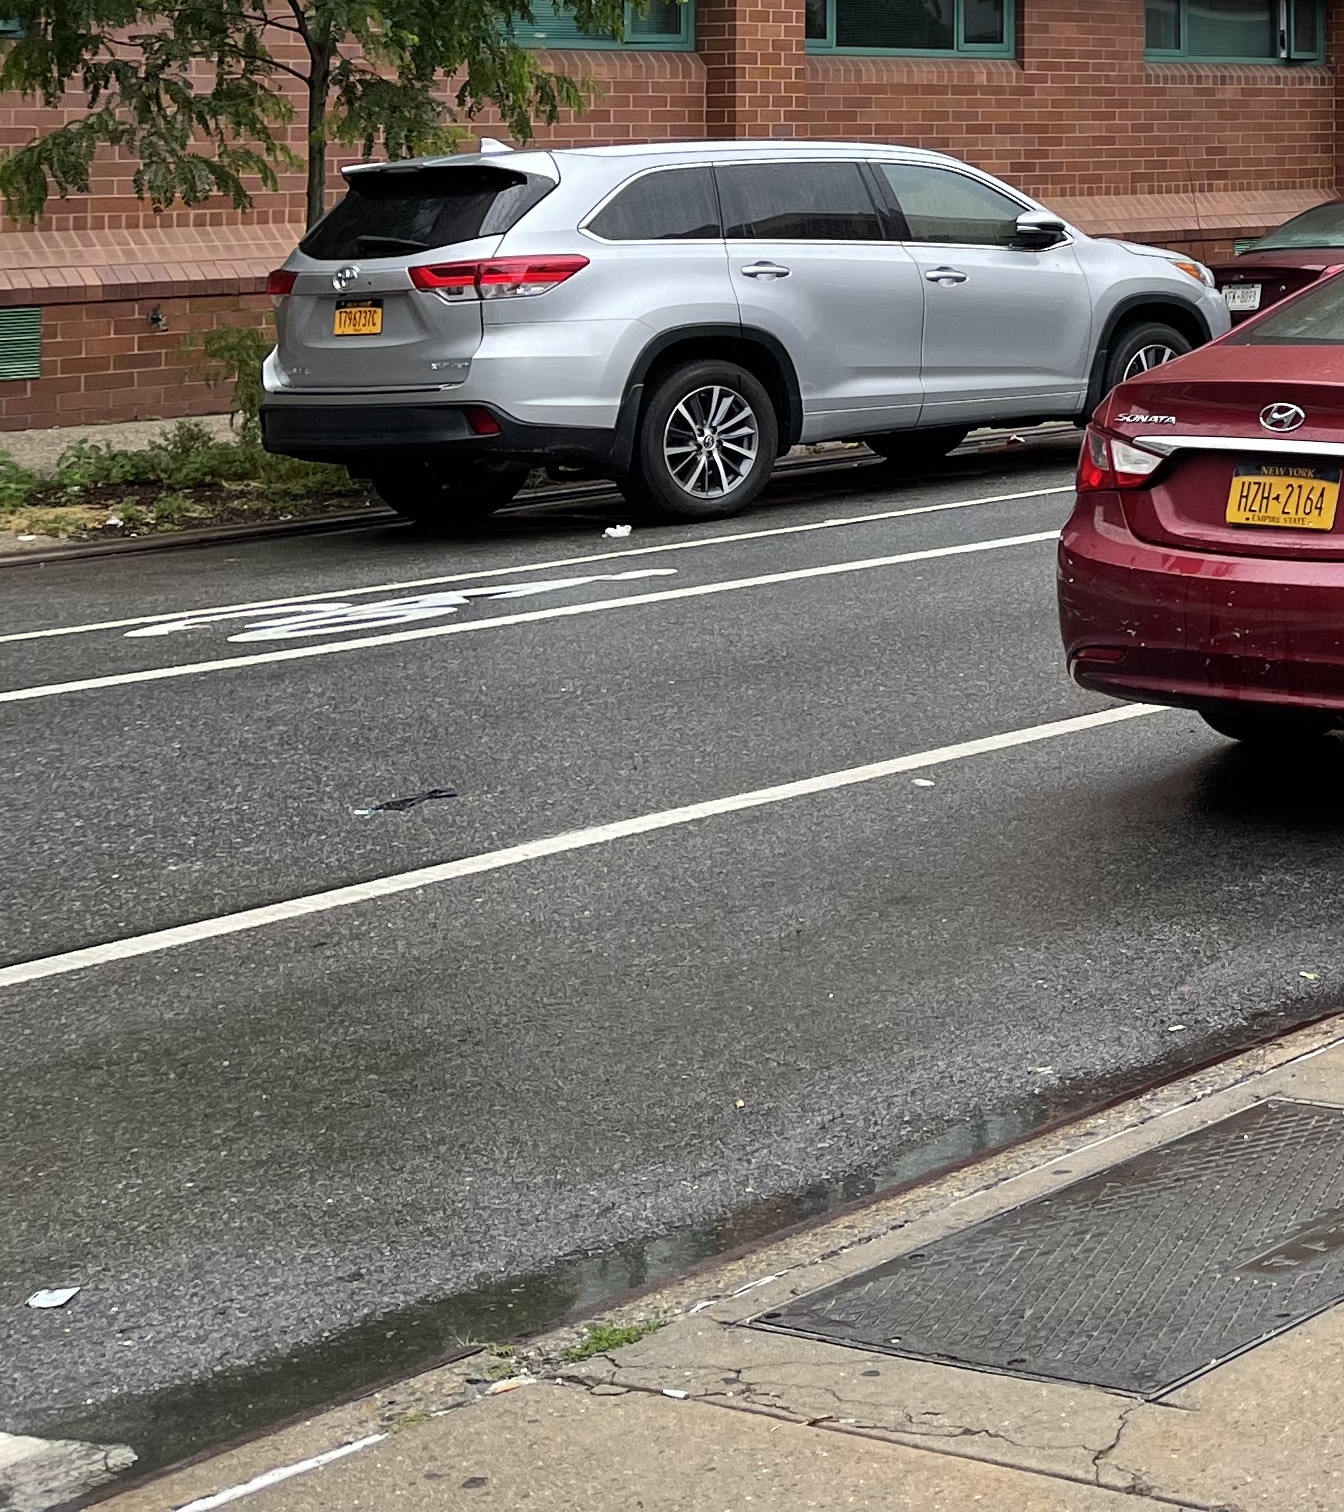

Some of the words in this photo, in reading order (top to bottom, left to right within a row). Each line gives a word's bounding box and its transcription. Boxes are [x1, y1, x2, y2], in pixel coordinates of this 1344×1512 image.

[1113, 413, 1176, 425] SONATA
[1260, 465, 1285, 476] NEW
[1288, 467, 1316, 478] YORK
[1281, 483, 1326, 517] 2164
[1251, 514, 1281, 524] EMPIRE
[1283, 517, 1307, 526] STATE
